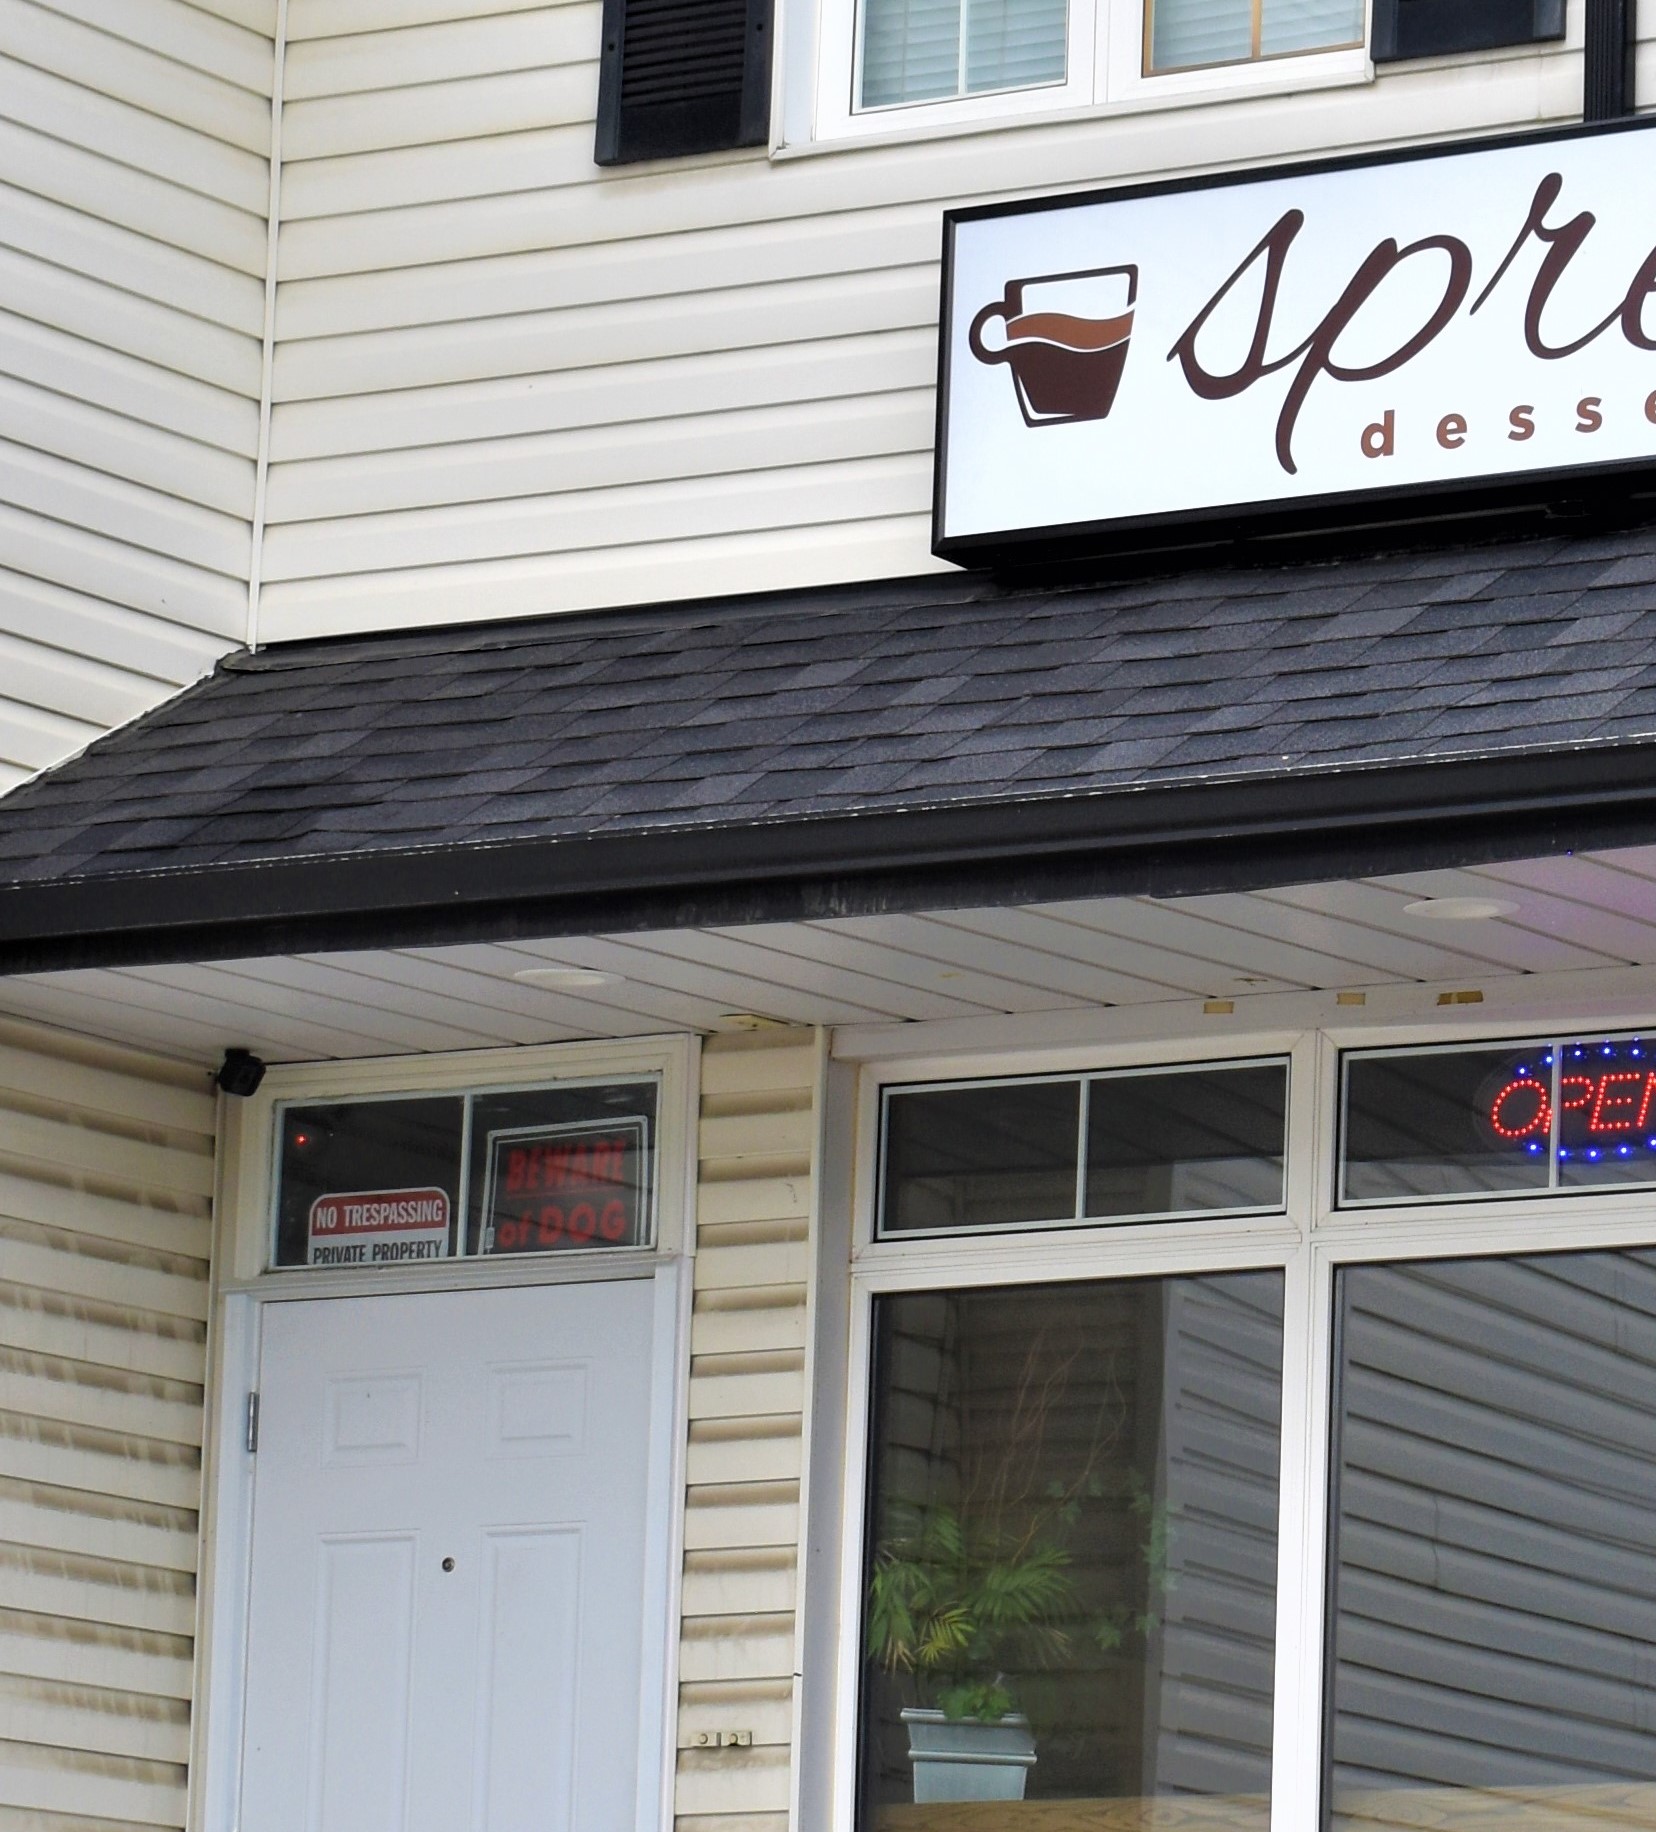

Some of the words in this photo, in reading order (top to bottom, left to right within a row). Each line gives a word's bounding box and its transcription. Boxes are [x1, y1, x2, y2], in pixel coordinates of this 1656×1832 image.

[316, 1207, 337, 1229] NO
[344, 1200, 443, 1227] TRESPASSING
[539, 1200, 626, 1245] DOG
[313, 1245, 367, 1264] PRIVATE
[372, 1240, 443, 1261] PROPERTY
